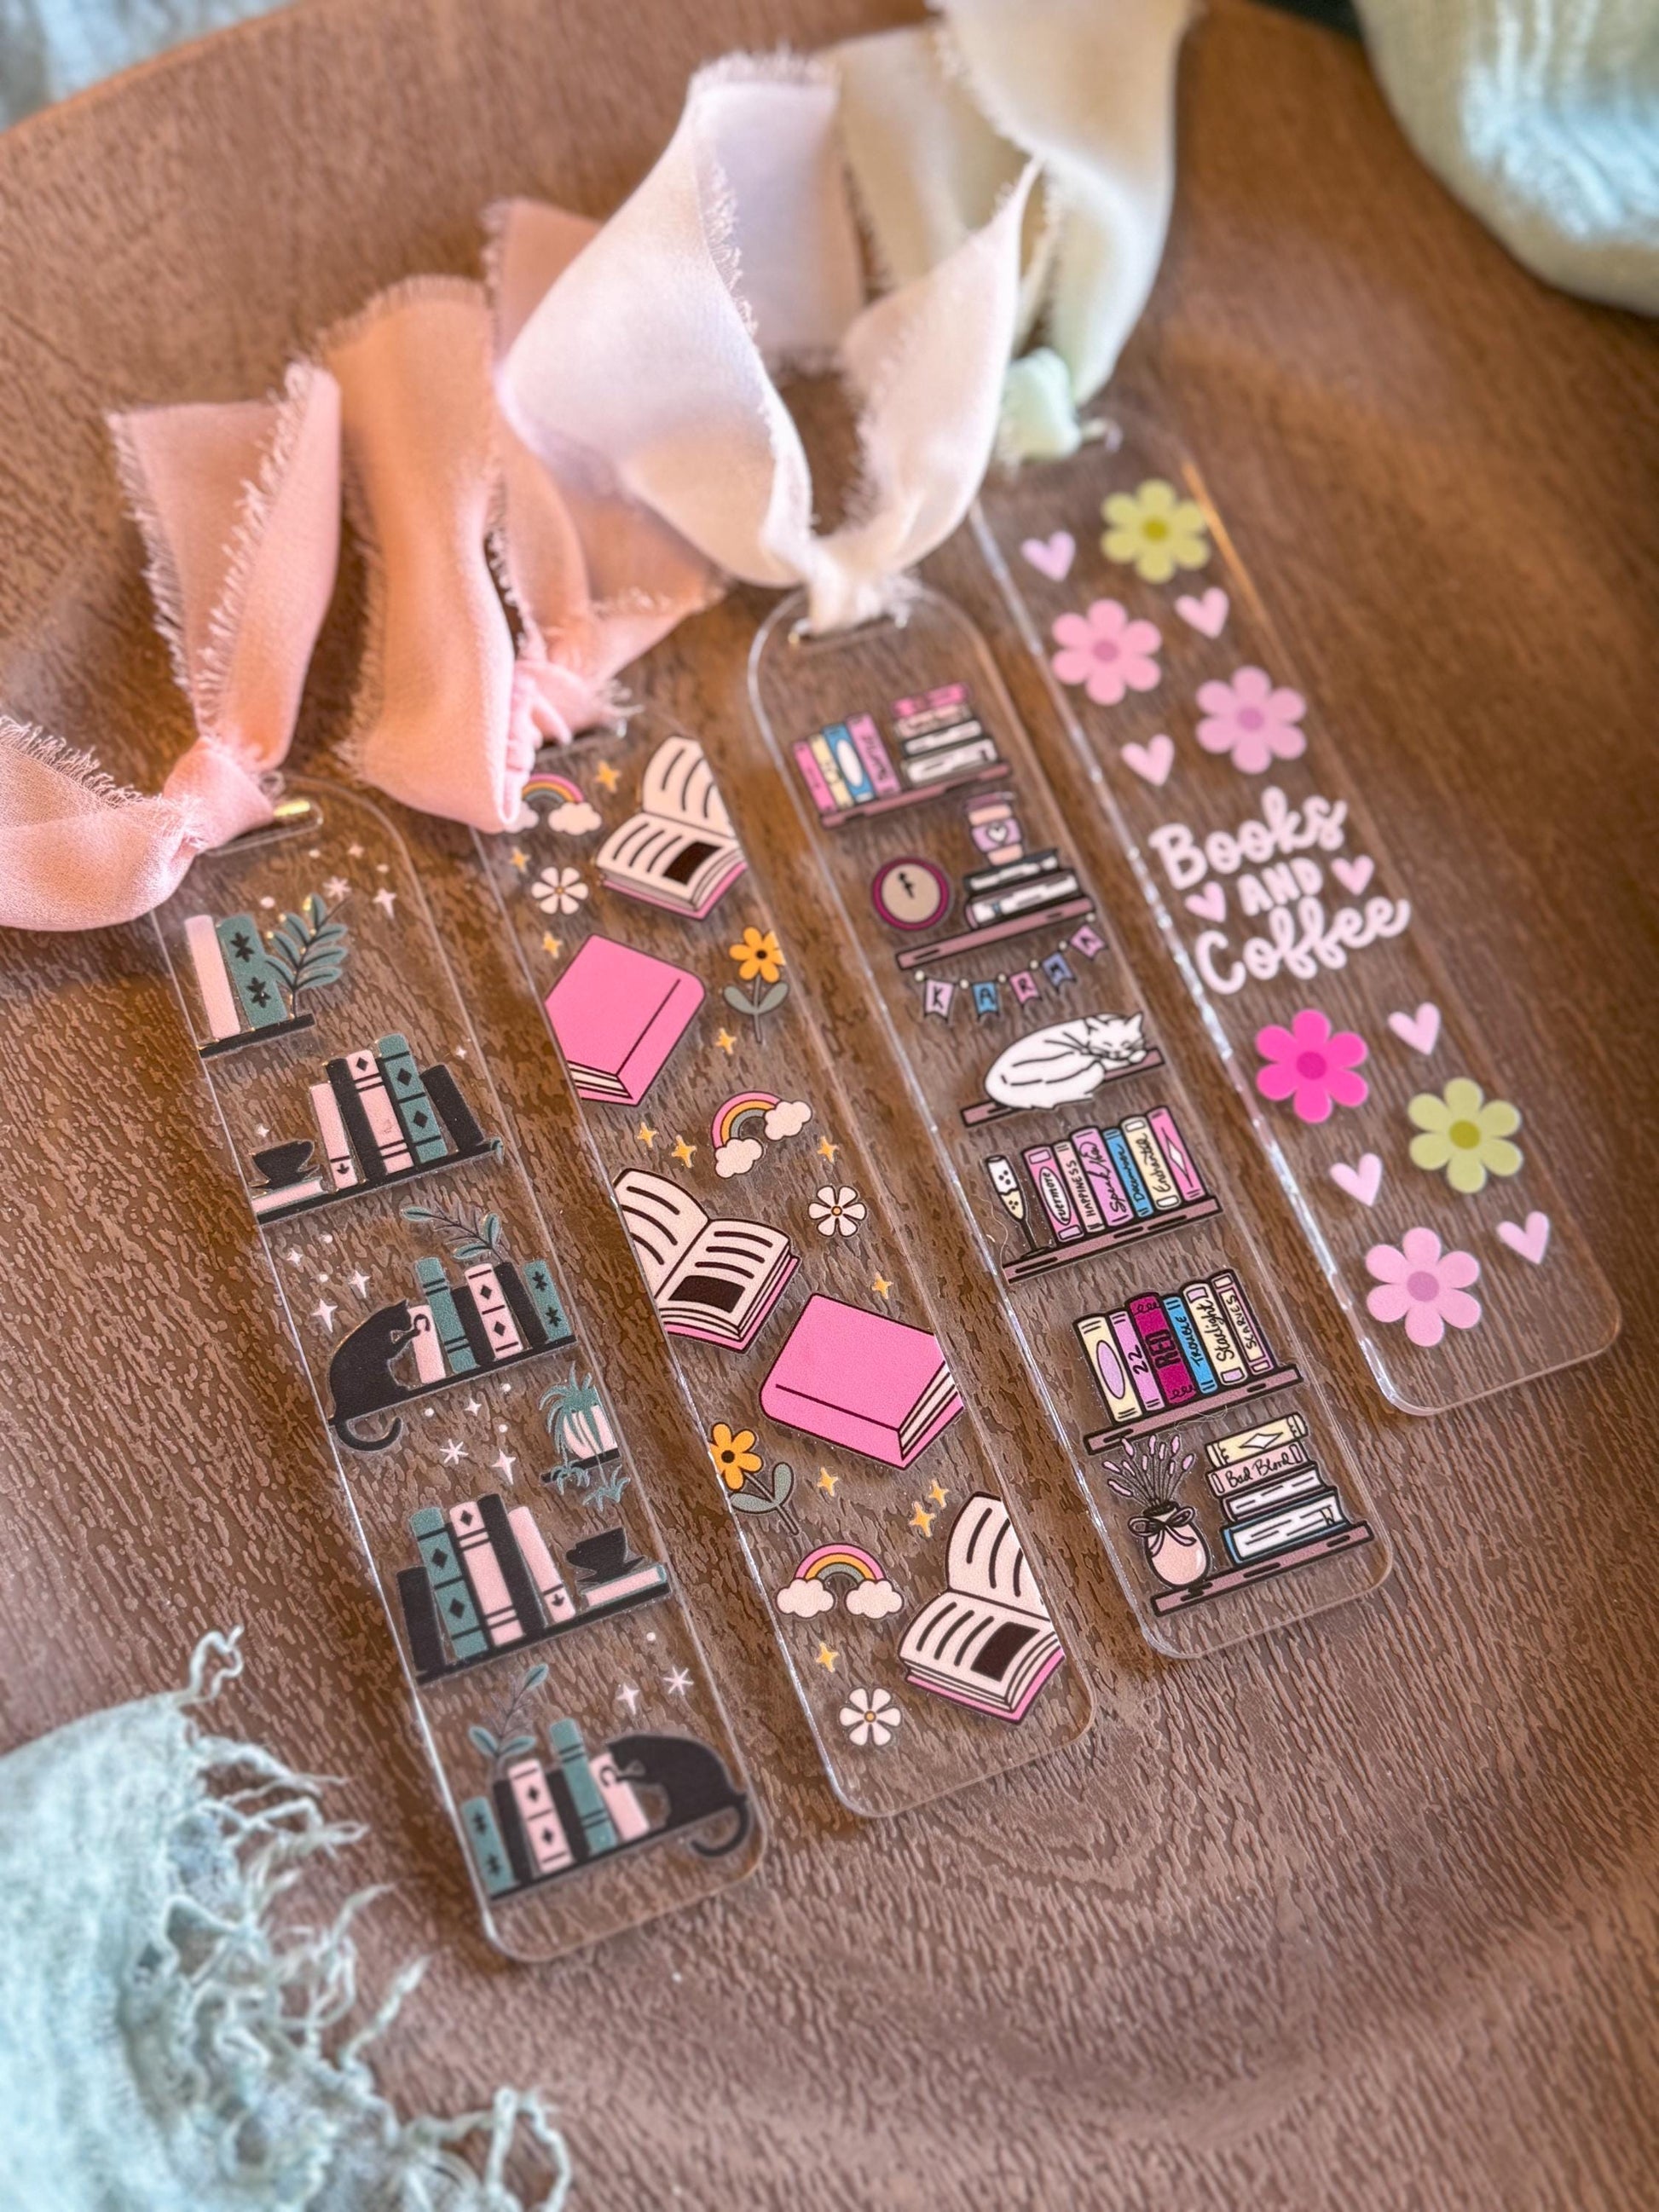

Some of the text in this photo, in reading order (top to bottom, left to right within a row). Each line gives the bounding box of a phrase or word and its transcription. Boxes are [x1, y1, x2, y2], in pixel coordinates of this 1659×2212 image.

[1147, 786, 1348, 890] Books
[1238, 858, 1322, 916] AND
[1194, 895, 1411, 994] Coffee
[1042, 1171, 1071, 1223] evermore
[1066, 1159, 1095, 1217] HAPPINESS
[1145, 1330, 1182, 1369] RED
[1176, 1315, 1202, 1367] TROUBLE
[1195, 1299, 1235, 1361] Starlight
[1226, 1294, 1257, 1350] SCARVES
[1128, 1344, 1148, 1375] 22
[1224, 1466, 1253, 1487] Bad
